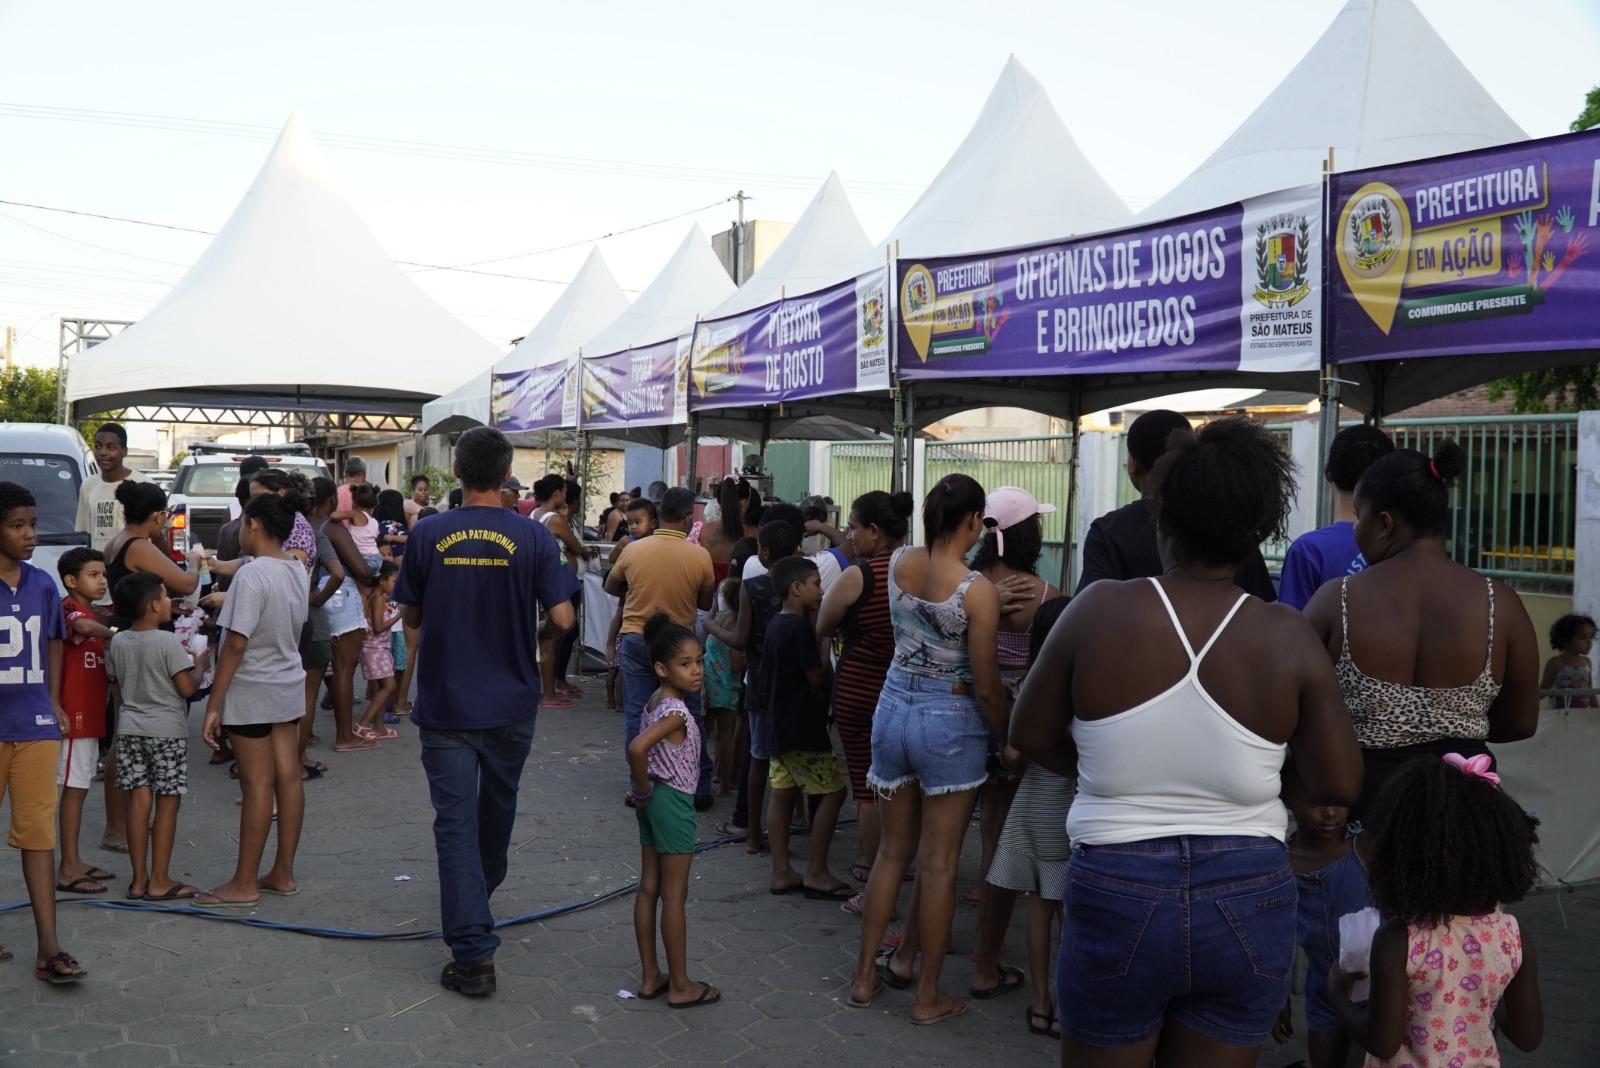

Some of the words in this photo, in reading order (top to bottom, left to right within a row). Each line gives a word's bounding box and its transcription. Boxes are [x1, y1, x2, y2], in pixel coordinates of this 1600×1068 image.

[1415, 165, 1540, 223] PREFEITURA
[1015, 245, 1106, 300] OFICINAS
[1113, 240, 1141, 290] DE
[1148, 226, 1226, 287] JOGOS
[1416, 246, 1436, 271] EM
[1441, 227, 1494, 277] AÇÃO
[937, 261, 991, 293] PREFEITURA
[769, 302, 821, 349] PINTURA
[1037, 310, 1049, 354] E
[1054, 295, 1197, 353] BRINQUEDOS
[1250, 311, 1299, 323] PREFEITURA
[1301, 310, 1313, 319] DE
[1408, 300, 1474, 319] COMUNIDADE
[1476, 294, 1527, 311] PRESENTE
[1250, 341, 1268, 349] ESTADO
[1251, 323, 1271, 337] SÃO
[1273, 322, 1313, 336] MATEUS
[765, 356, 780, 392] DE
[784, 346, 824, 389] ROSTO
[436, 531, 468, 553] GUARDA
[468, 529, 518, 555] PATRIMONIAL
[443, 557, 470, 566] SECRETARIA
[470, 558, 477, 566] DE
[493, 559, 510, 567] SOCIAL
[0, 615, 44, 684] 21
